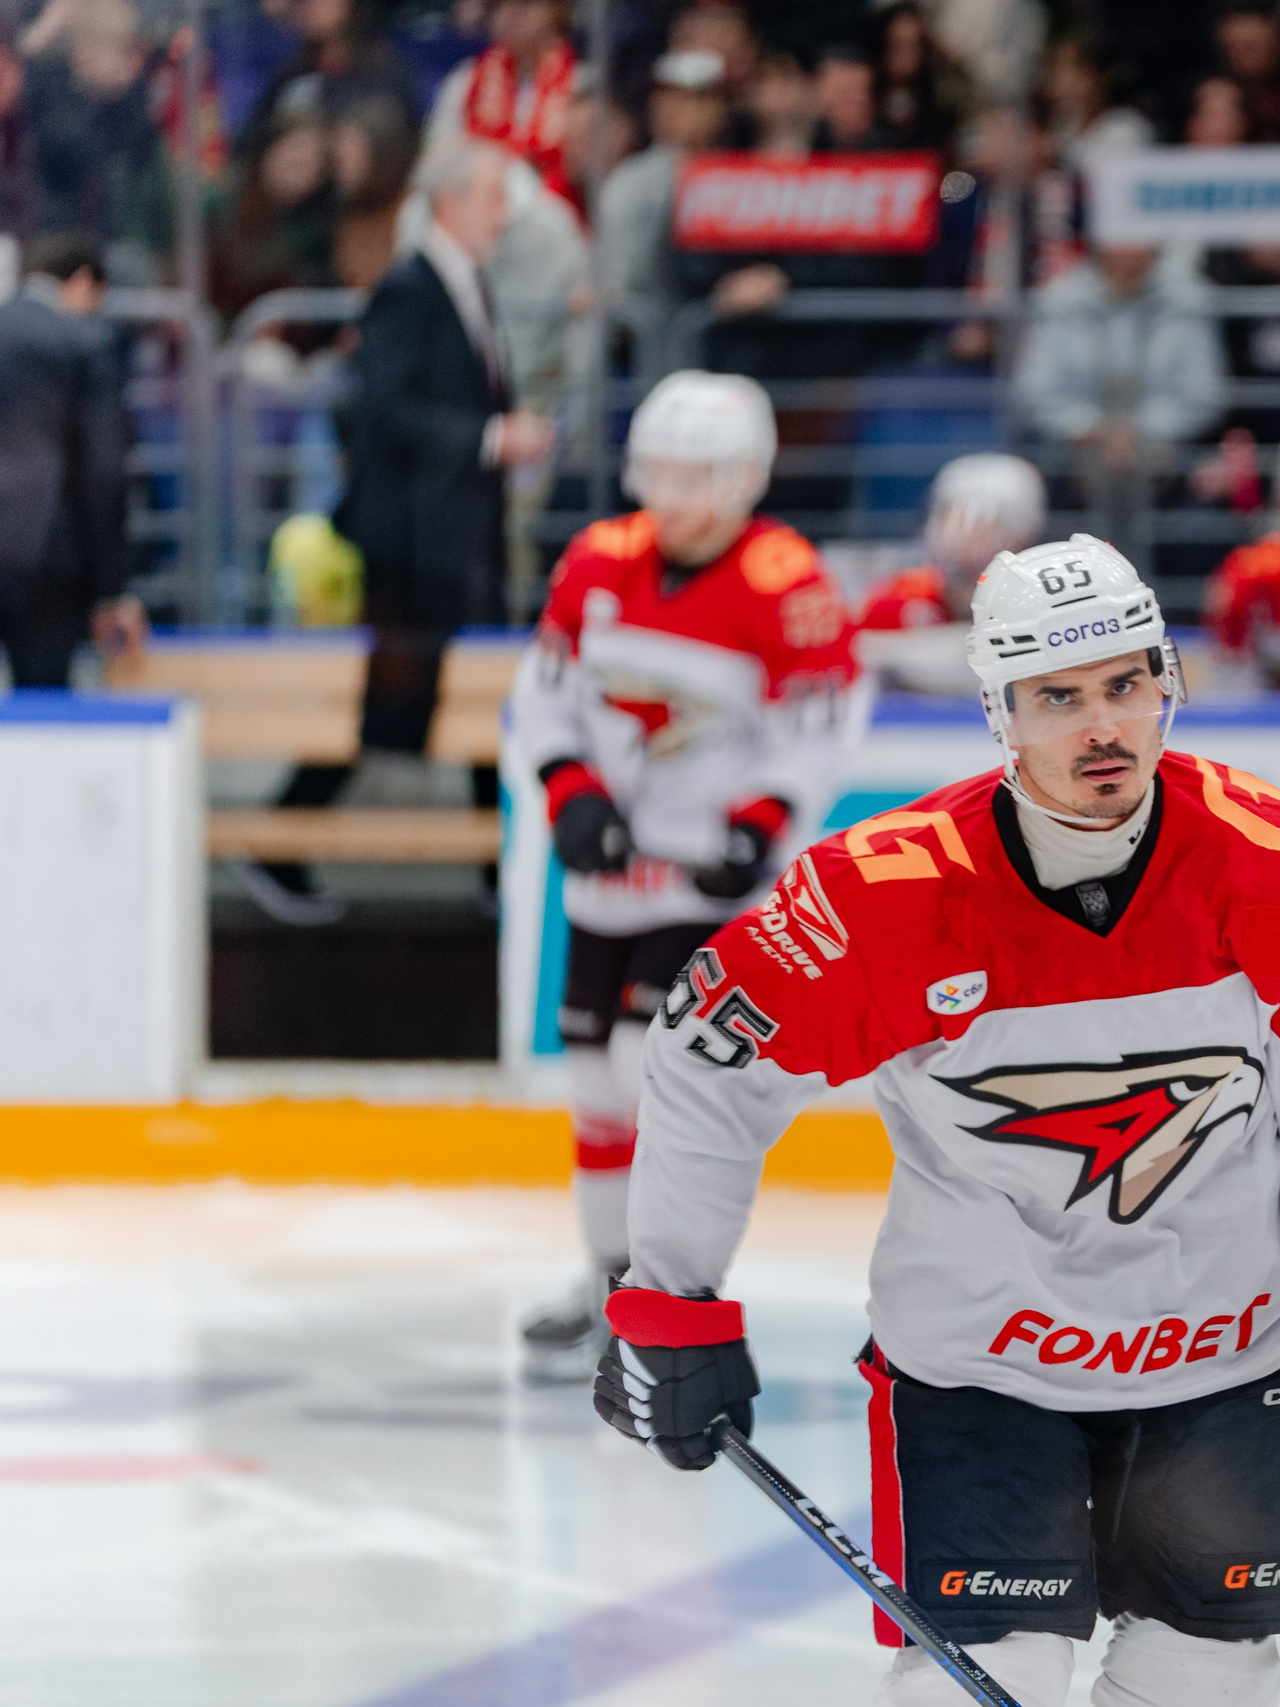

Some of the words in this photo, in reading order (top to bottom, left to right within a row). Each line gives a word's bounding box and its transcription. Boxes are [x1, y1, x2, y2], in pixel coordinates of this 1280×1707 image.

[1037, 560, 1092, 595] 65
[988, 1293, 1272, 1375] FONBET
[794, 1497, 894, 1588] CCM
